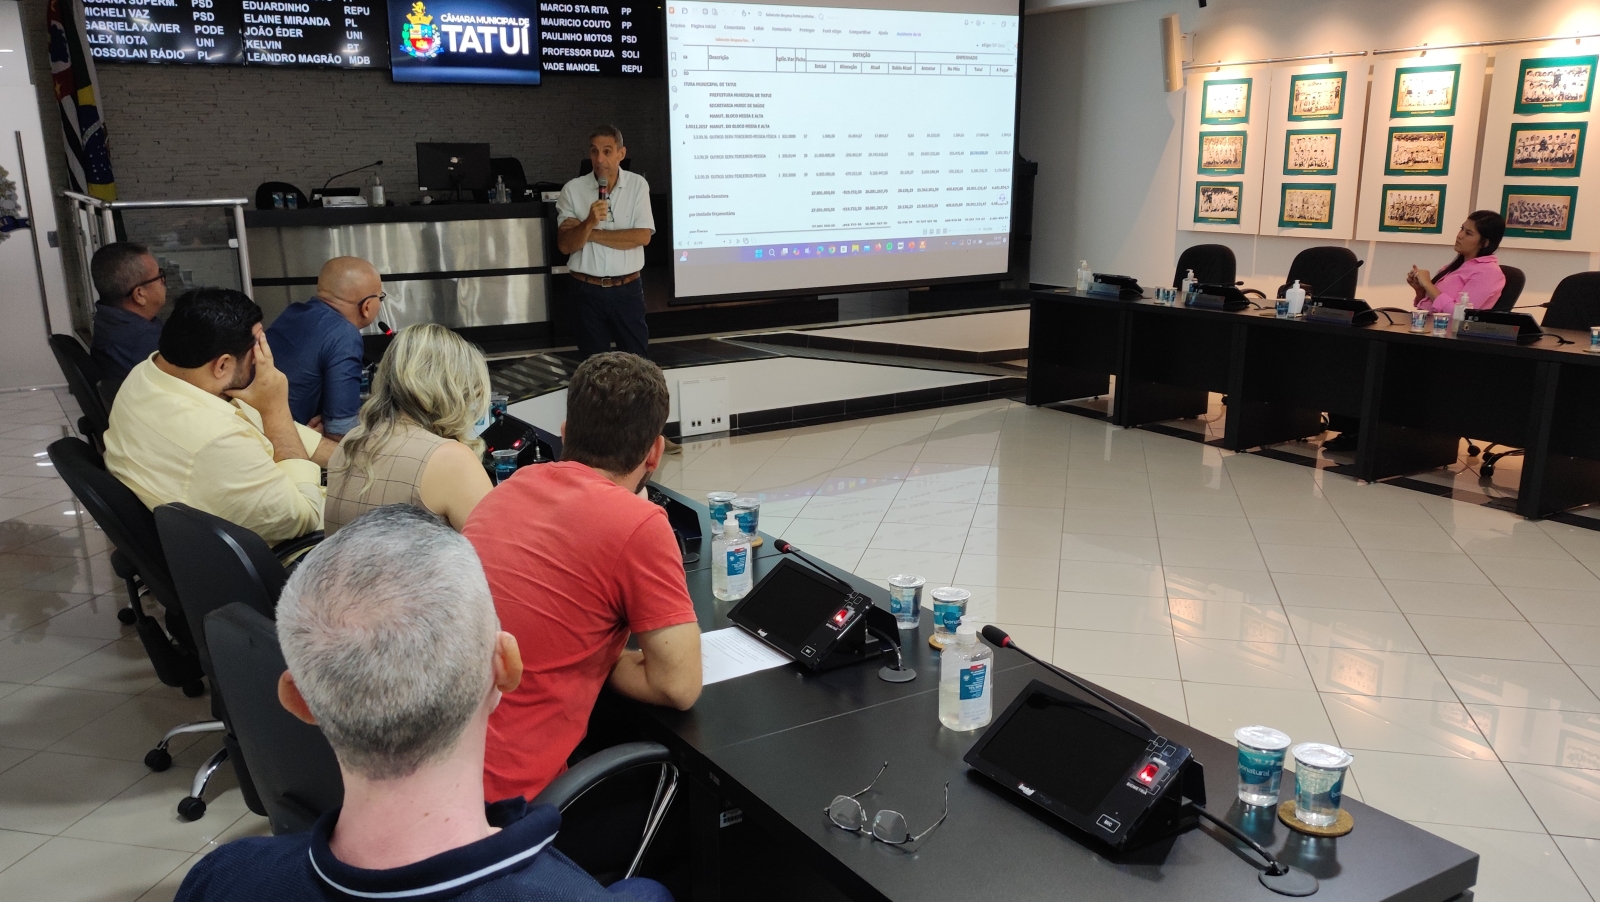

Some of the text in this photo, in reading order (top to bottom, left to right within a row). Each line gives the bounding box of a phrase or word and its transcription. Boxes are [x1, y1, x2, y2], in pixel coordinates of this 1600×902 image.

[192, 0, 213, 8] PSD
[243, 1, 370, 15] EDUARDINHO REPU
[541, 3, 573, 12] MARCIO
[574, 5, 590, 13] STA
[591, 6, 609, 14] RITA
[128, 9, 150, 19] VAZ
[193, 12, 214, 21] PSD
[244, 14, 358, 27] ELAINE MIRANDA PL
[441, 13, 530, 27] CÂMARA MUNICIPAL DE
[141, 23, 180, 34] XAVIER
[194, 25, 224, 35] PODE
[541, 18, 581, 27] MAURICIO
[583, 20, 611, 28] COUTO
[246, 26, 362, 40] JOÃO ÉDER UNI
[441, 24, 529, 54] TATUÍ
[542, 32, 582, 41] PAULINHO
[584, 34, 612, 42] MOTOS
[116, 35, 148, 45] MOTA
[196, 38, 214, 47] UNI
[246, 40, 359, 52] KELVIN PT
[150, 48, 185, 59] RÁDIO
[197, 51, 211, 60] PL
[542, 47, 592, 57] PROFESSOR
[248, 53, 370, 64] LEANDRO MAGRÃO MDB
[543, 62, 564, 70] VADE
[566, 63, 600, 72] MANOEL
